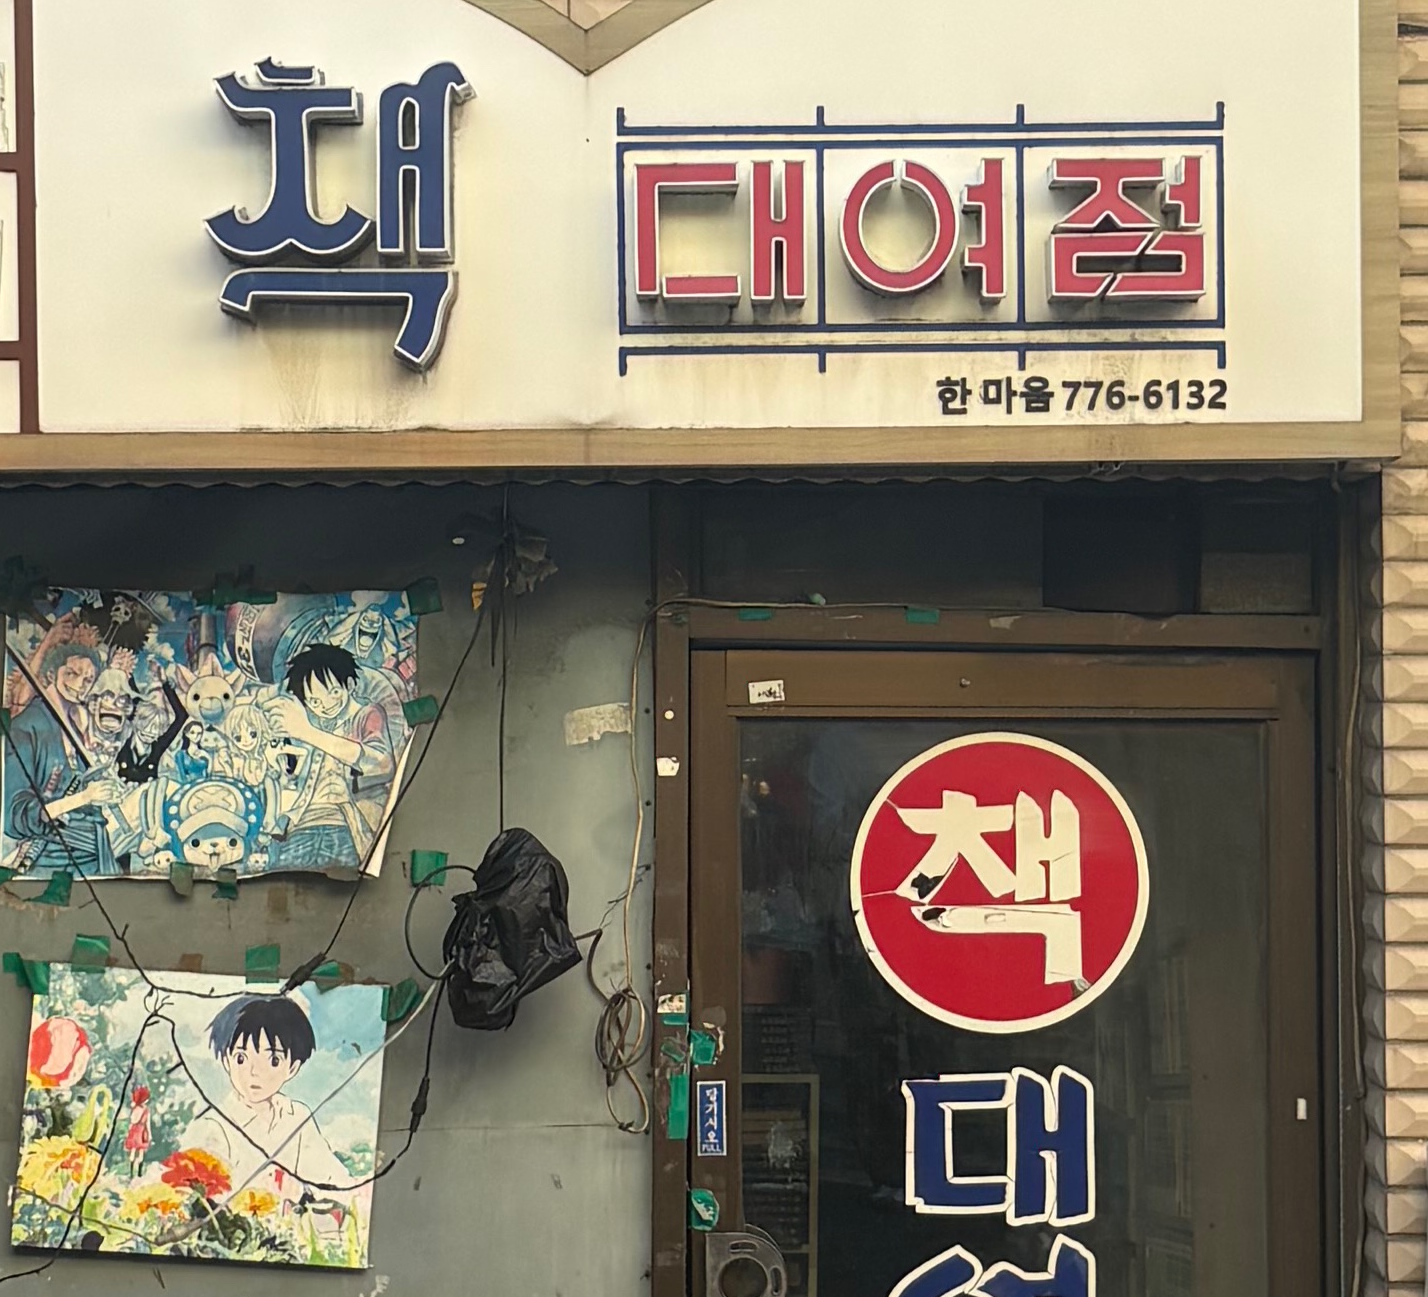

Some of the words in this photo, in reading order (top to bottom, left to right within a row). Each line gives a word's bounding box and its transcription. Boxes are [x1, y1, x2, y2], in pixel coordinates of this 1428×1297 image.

[204, 56, 477, 373] 책
[634, 155, 1207, 303] 대여점
[1061, 378, 1228, 412] 776-6132
[891, 789, 1092, 997] 책
[704, 1087, 720, 1143] 당기시오
[701, 1143, 722, 1153] PULL
